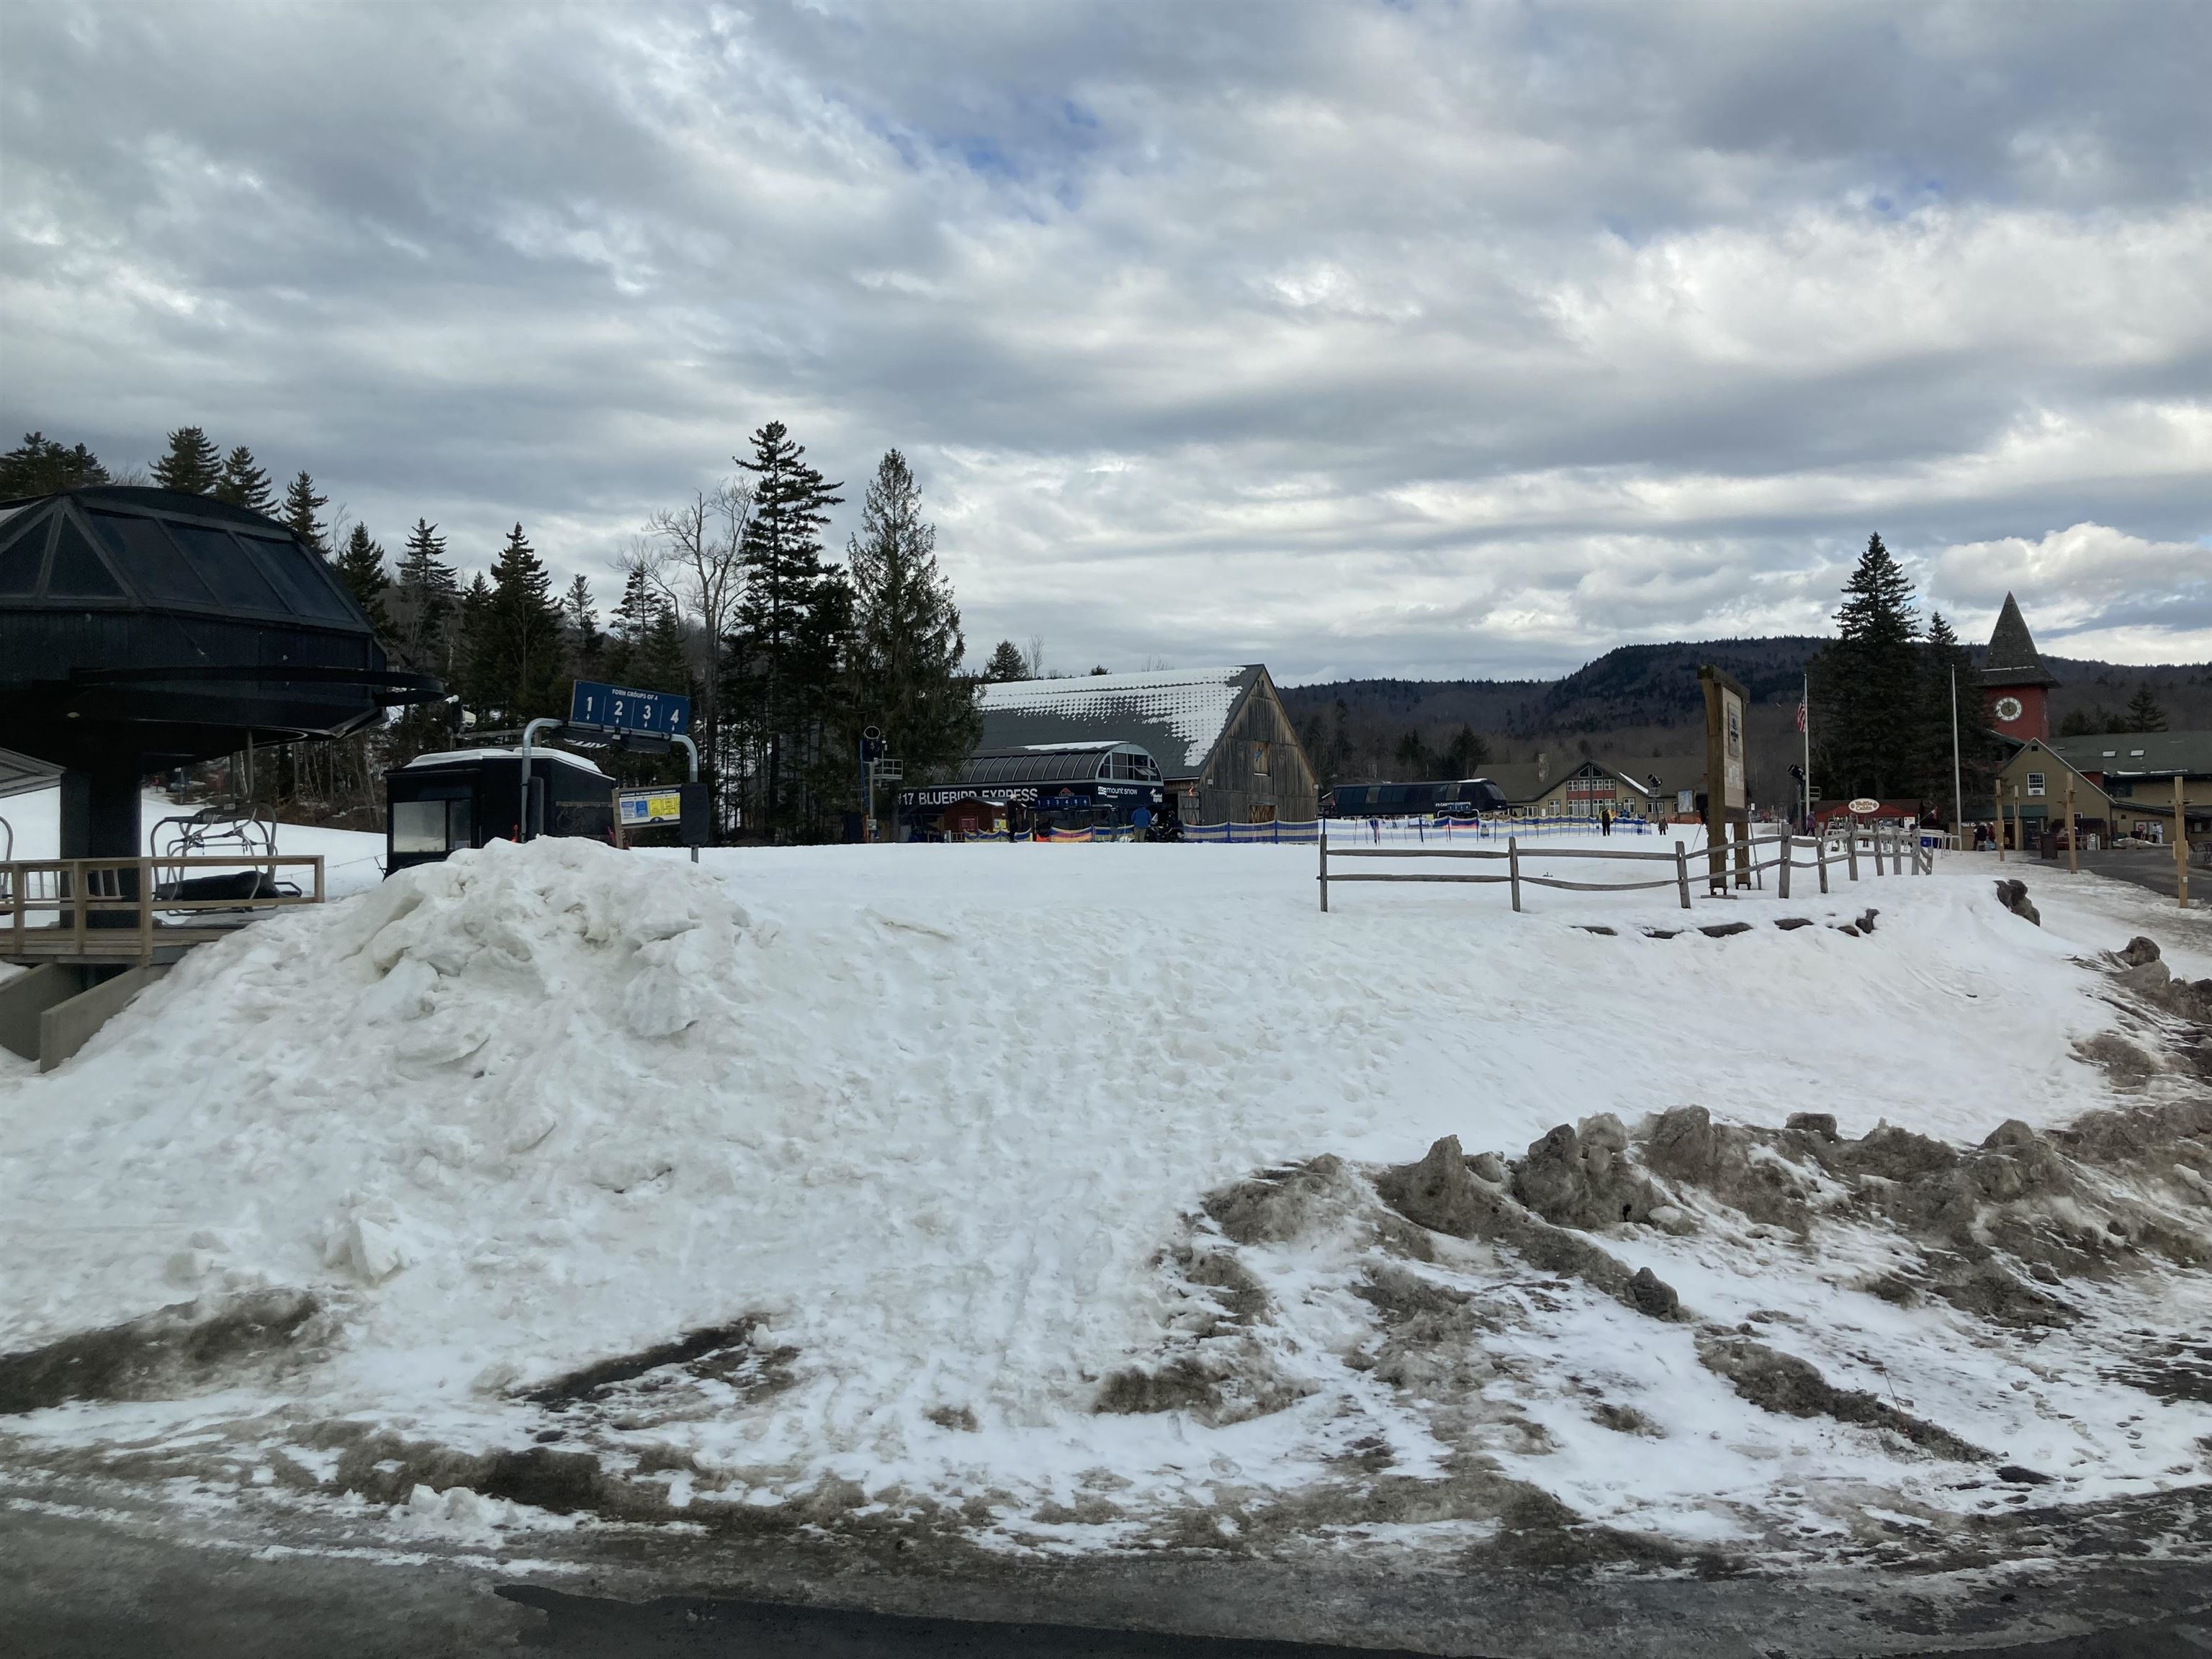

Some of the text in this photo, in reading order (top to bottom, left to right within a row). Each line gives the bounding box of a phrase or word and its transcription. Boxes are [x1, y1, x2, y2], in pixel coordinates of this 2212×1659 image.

[588, 696, 679, 724] 1 2 3 4
